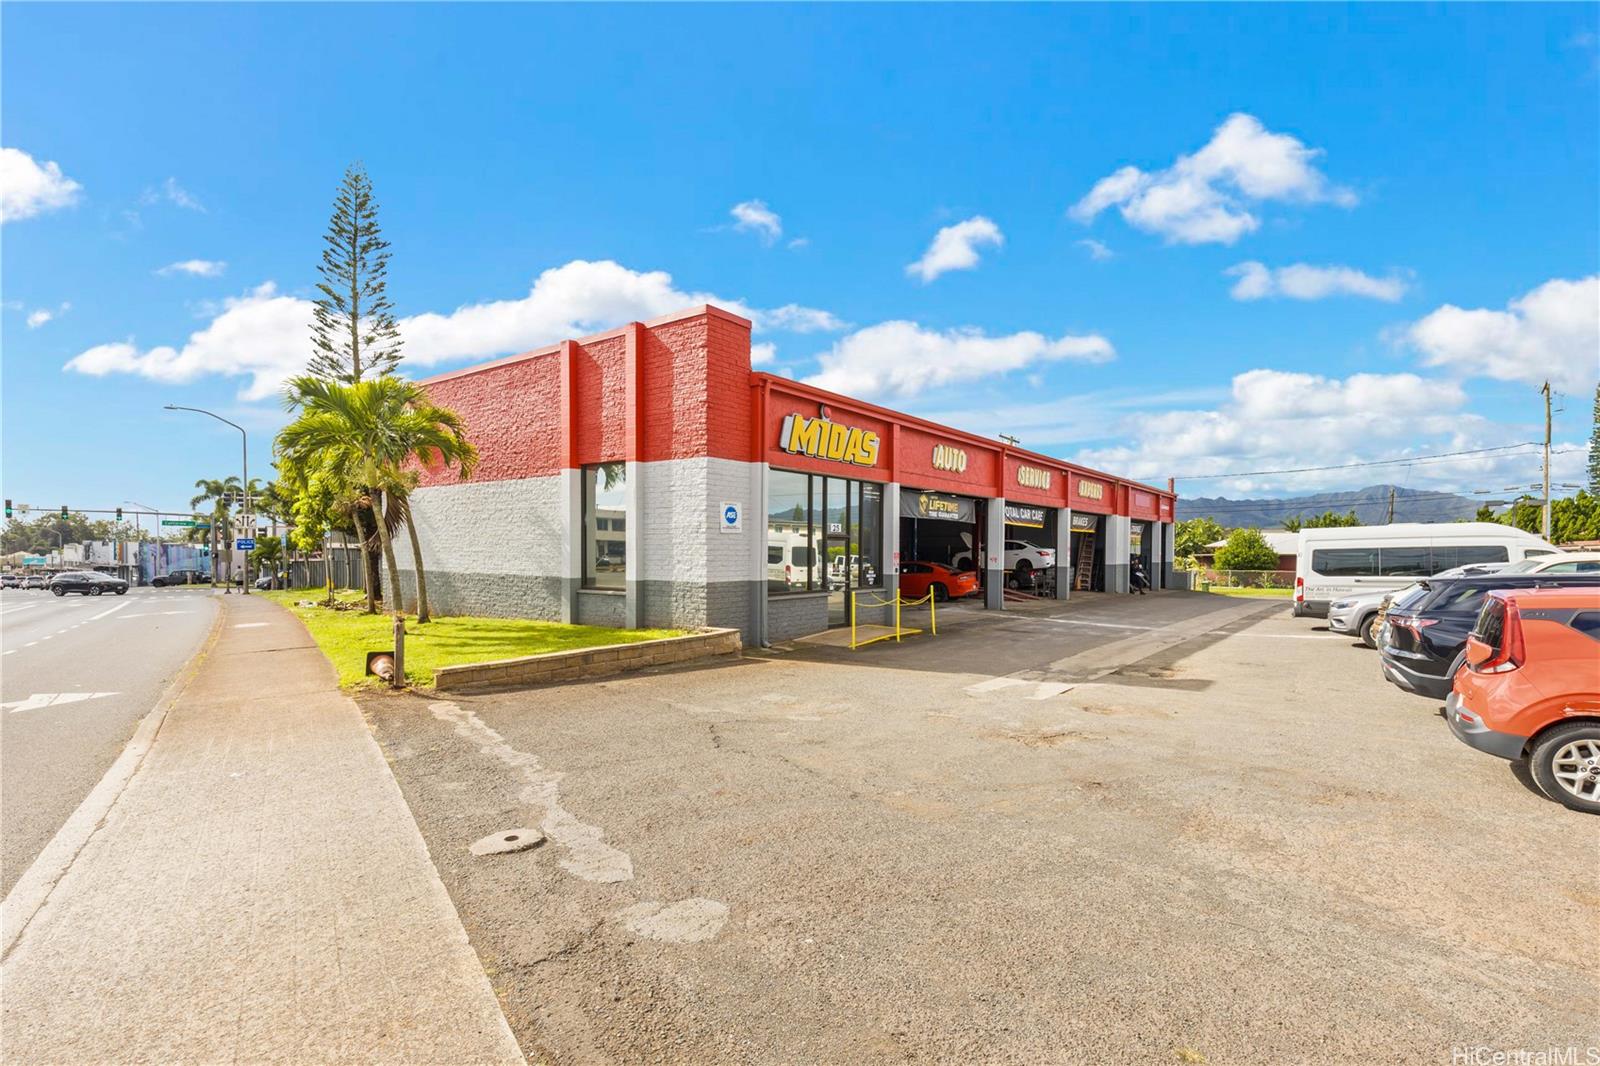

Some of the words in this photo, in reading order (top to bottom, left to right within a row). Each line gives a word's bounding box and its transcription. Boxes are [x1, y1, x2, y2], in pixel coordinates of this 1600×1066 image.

[780, 413, 880, 467] MIDAS
[932, 444, 967, 473] AUTO
[1017, 465, 1051, 490] SERVICE
[929, 499, 959, 512] LIFETIME
[1004, 506, 1019, 519] OTAL
[1020, 508, 1031, 521] CAR
[1031, 510, 1044, 522] CARE
[1072, 516, 1089, 527] BRAKES
[832, 524, 840, 532] 25
